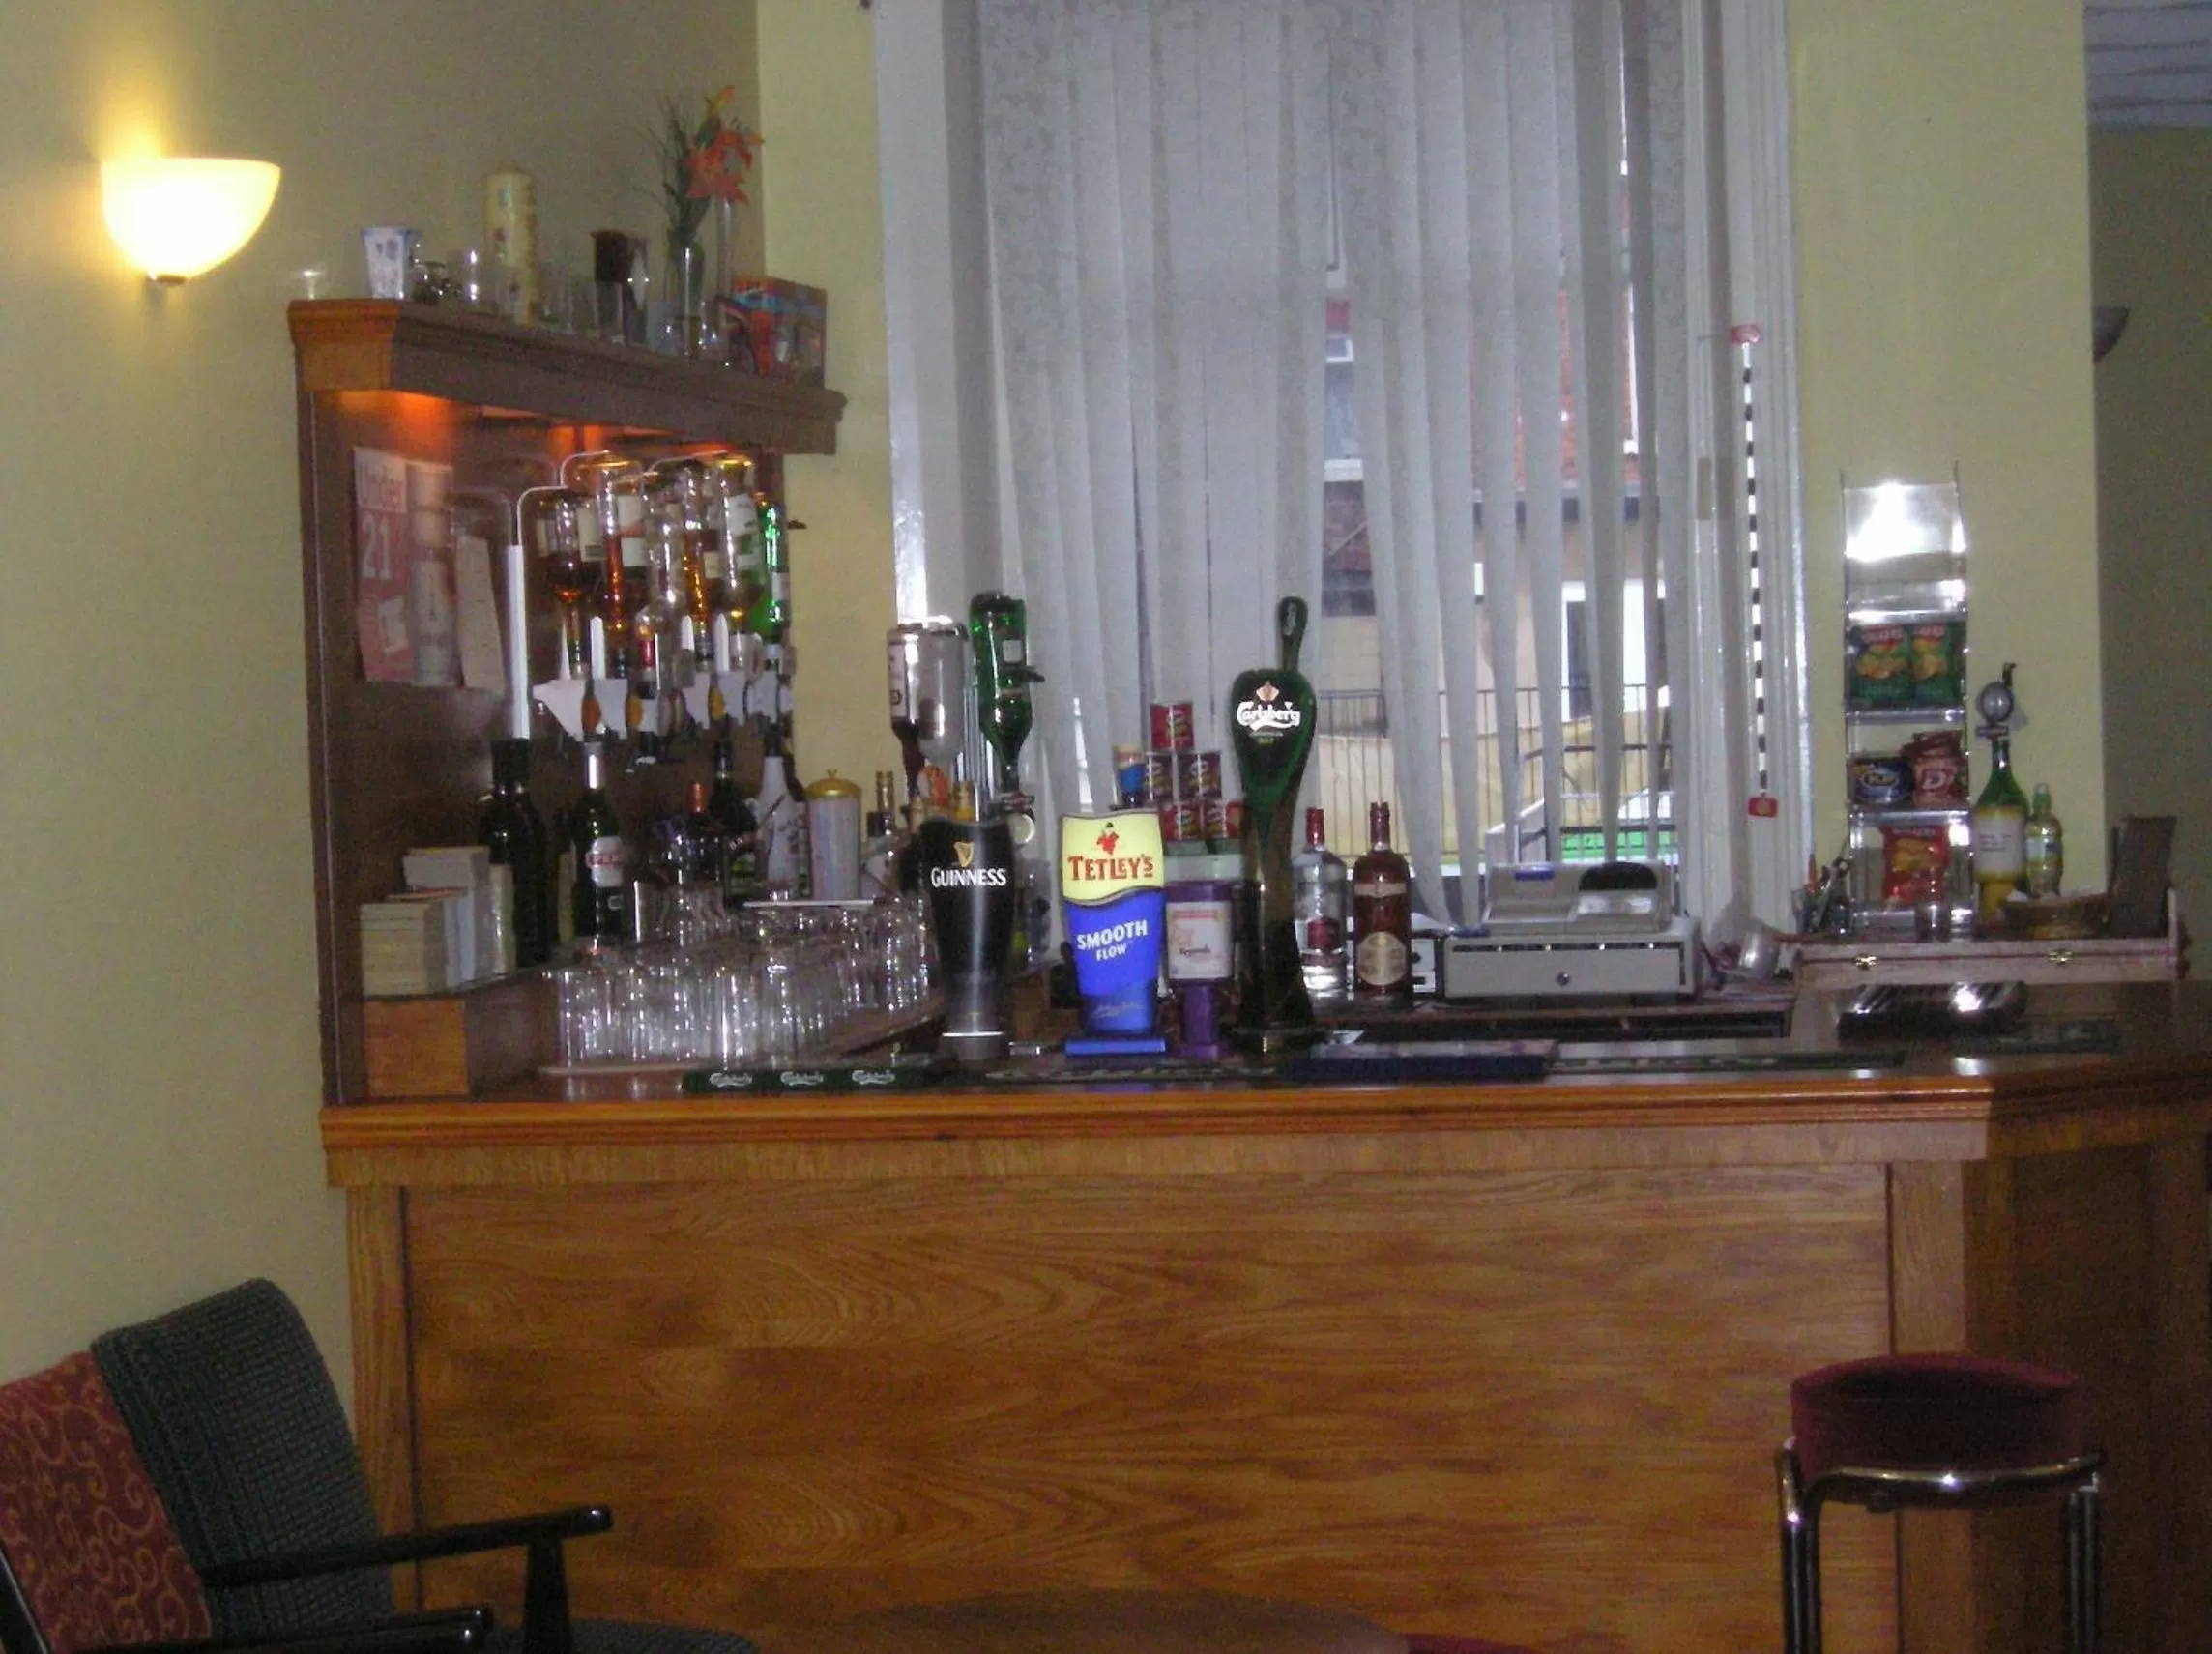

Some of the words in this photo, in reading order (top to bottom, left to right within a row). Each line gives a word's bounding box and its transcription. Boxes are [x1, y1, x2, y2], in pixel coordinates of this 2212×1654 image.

[361, 511, 392, 580] 21
[1237, 701, 1301, 731] Carlsberg
[930, 866, 1007, 887] GUINNESS
[1067, 855, 1154, 881] TETLEY'S
[1076, 919, 1148, 950] SMOOTH
[1095, 943, 1127, 962] FLOW
